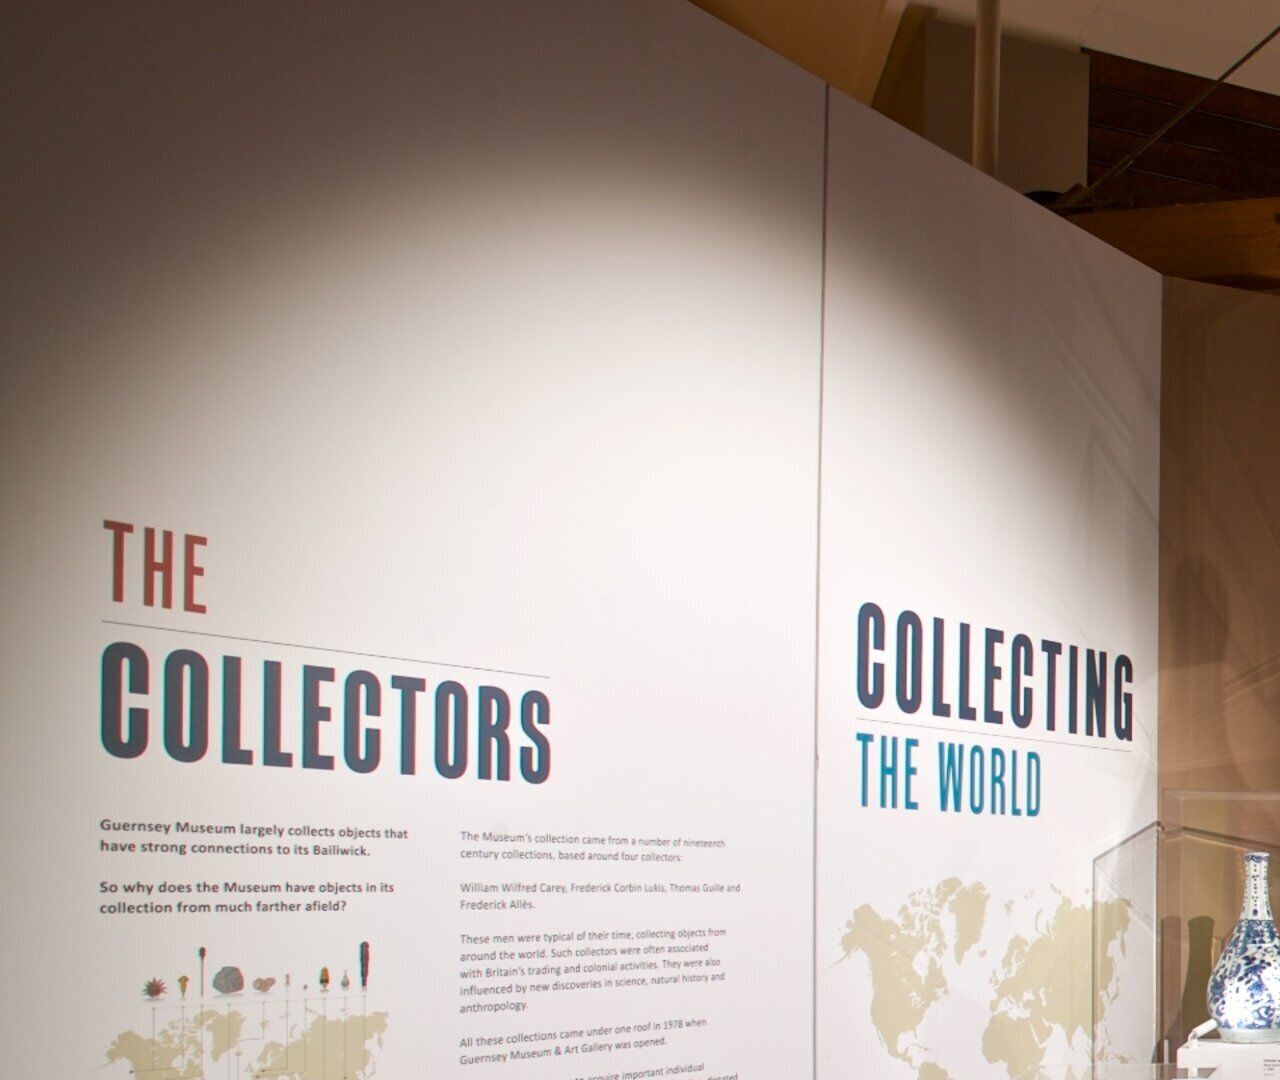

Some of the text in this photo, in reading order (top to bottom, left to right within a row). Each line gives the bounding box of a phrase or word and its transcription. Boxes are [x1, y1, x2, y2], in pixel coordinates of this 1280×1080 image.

[103, 519, 207, 614] THE
[857, 602, 1133, 741] COLLECTING
[100, 641, 550, 785] COLLECTORS
[856, 732, 1041, 817] THE WORLD
[100, 818, 408, 840] Guernsey Museum largely collects objects that
[100, 839, 370, 856] have strong connections to its Bailiwick.
[460, 830, 725, 848] The Museum's collection came from a number of nineteenth
[460, 849, 683, 862] century collections, based around four collectors:
[99, 881, 394, 895] So why does the Museum have objects in its
[459, 882, 498, 893] William
[501, 882, 537, 893] Wilfred
[570, 882, 611, 893] Frederick
[613, 883, 642, 893] Corbin
[669, 883, 701, 893] Thomas
[726, 883, 740, 892] and
[99, 900, 347, 914] collection from much farther afield?
[460, 899, 506, 910] Frederick
[460, 934, 490, 944] These
[492, 935, 515, 943] men
[517, 934, 541, 943] were
[543, 931, 574, 944] typical
[576, 930, 586, 941] of
[587, 931, 610, 940] their
[635, 929, 675, 940] collecting
[677, 929, 706, 939] objects
[707, 927, 726, 937] from
[459, 950, 496, 962] around
[498, 950, 515, 960] the
[551, 948, 573, 958] Such
[575, 947, 618, 957] collectors
[619, 947, 641, 955] were
[642, 944, 665, 954] often
[667, 943, 709, 953] associated
